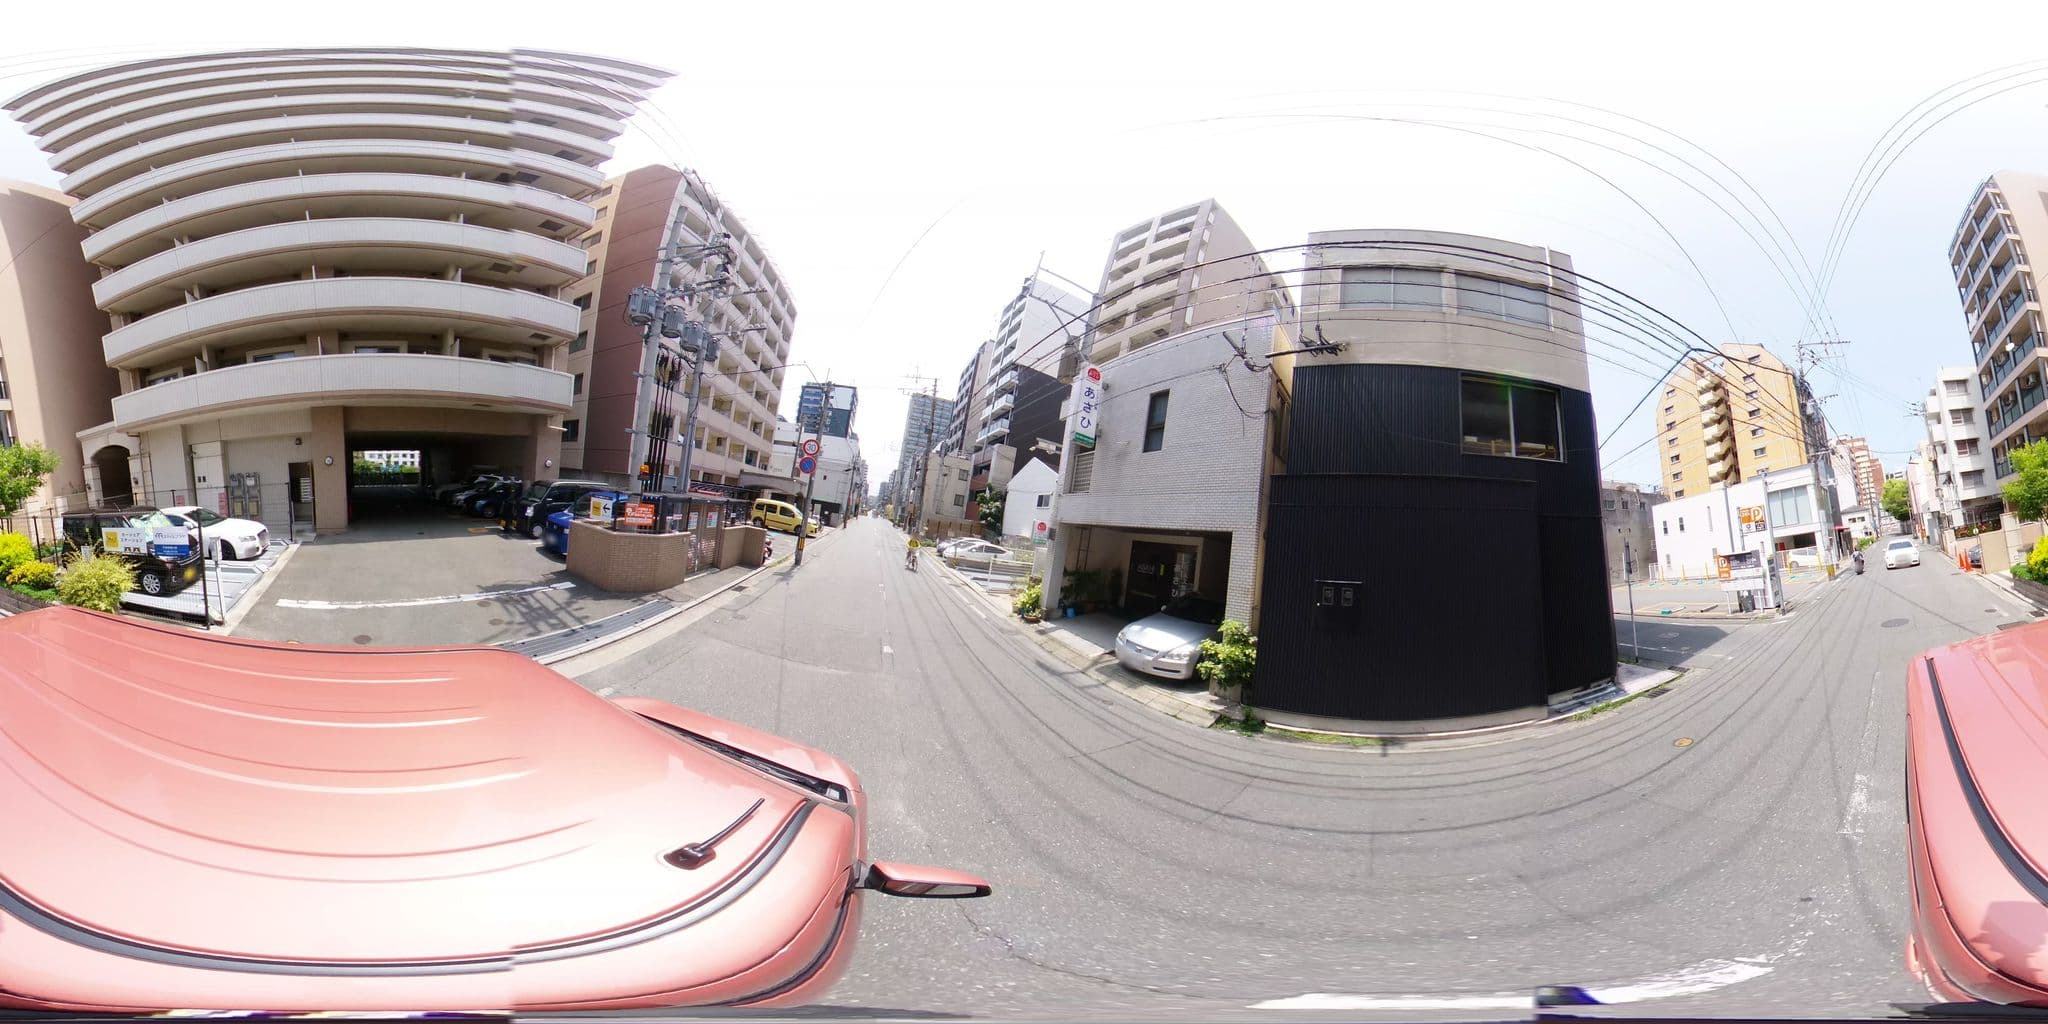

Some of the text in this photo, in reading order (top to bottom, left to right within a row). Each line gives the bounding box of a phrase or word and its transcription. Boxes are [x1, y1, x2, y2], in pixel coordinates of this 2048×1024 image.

[1080, 387, 1095, 429] あさひ
[807, 443, 816, 452] 30
[1751, 507, 1762, 522] P
